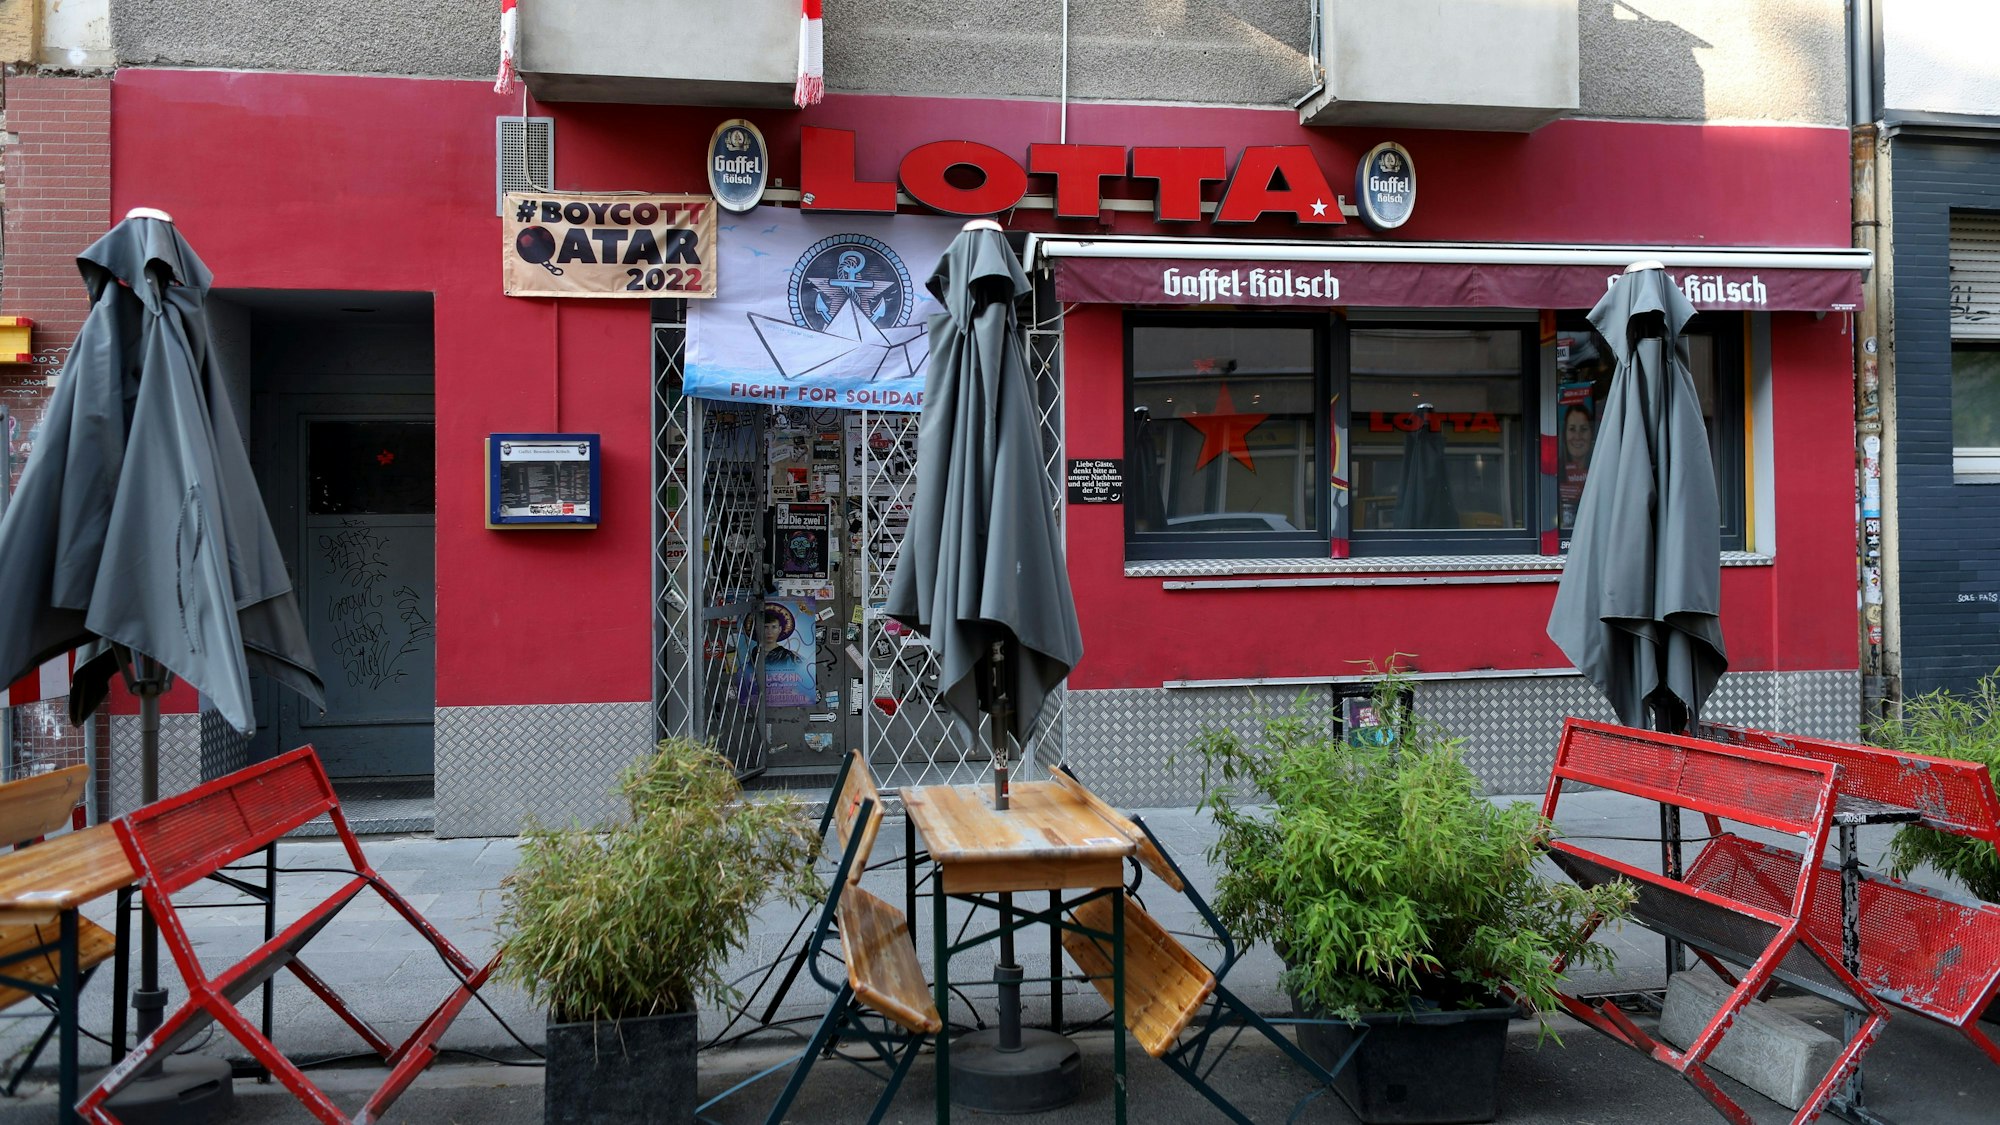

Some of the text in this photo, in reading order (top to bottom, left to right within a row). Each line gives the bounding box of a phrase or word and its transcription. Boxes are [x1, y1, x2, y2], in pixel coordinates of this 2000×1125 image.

[715, 155, 760, 174] Gaffel
[723, 174, 752, 185] Kölsch
[801, 126, 1346, 225] LOTTA
[1370, 176, 1410, 193] Gaffel
[1377, 193, 1403, 203] Kölsch
[516, 200, 706, 225] #BOYCOTT
[516, 226, 701, 270] QATAR
[627, 268, 702, 291] 2022
[1164, 268, 1340, 301] Gaffel-Kölsch
[730, 382, 789, 400] FIGHT
[799, 386, 837, 402] FOR
[790, 515, 802, 525] Die
